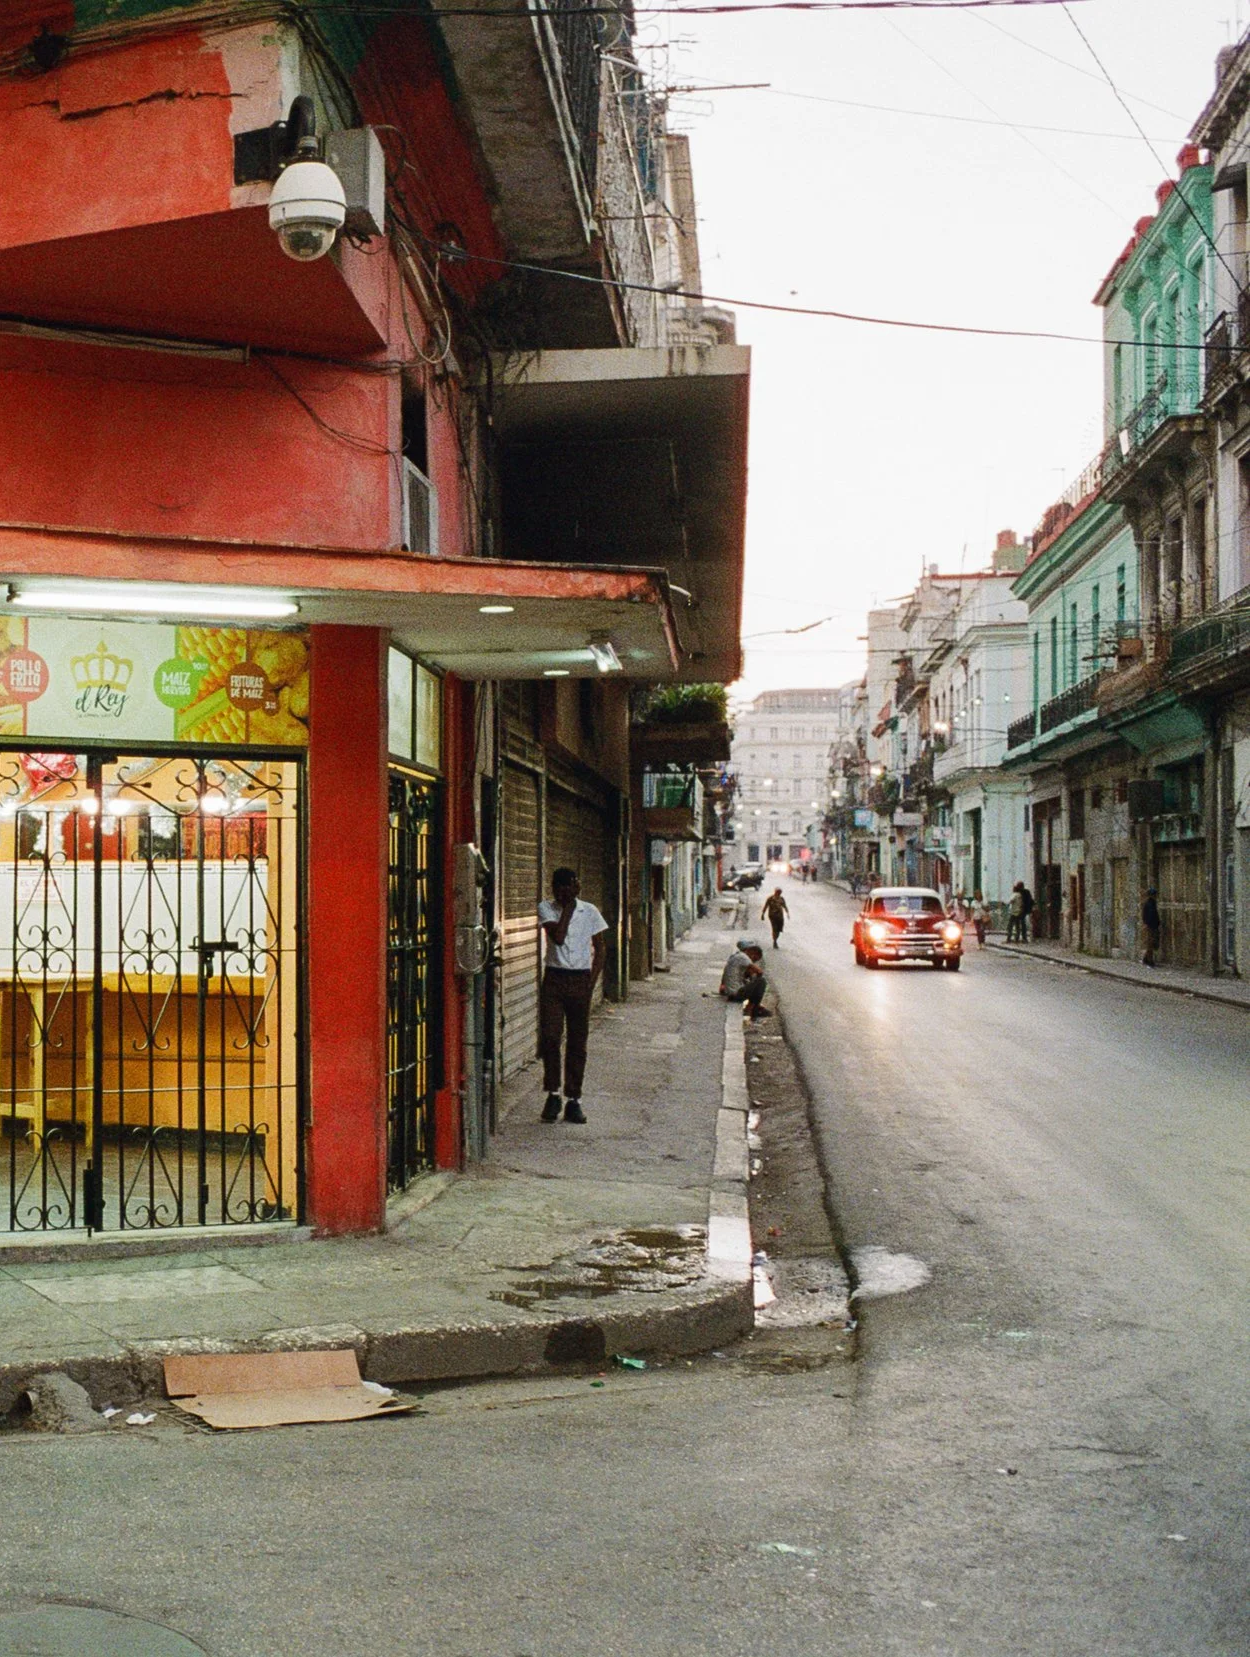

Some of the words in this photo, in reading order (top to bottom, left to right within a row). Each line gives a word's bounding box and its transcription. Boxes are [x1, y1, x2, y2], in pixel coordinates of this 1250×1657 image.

[10, 659, 41, 672] POLLO
[10, 671, 40, 687] FRITO
[230, 675, 264, 688] FRITURAS
[231, 688, 240, 698] DE
[75, 684, 91, 713] el
[94, 684, 130, 717] Rey
